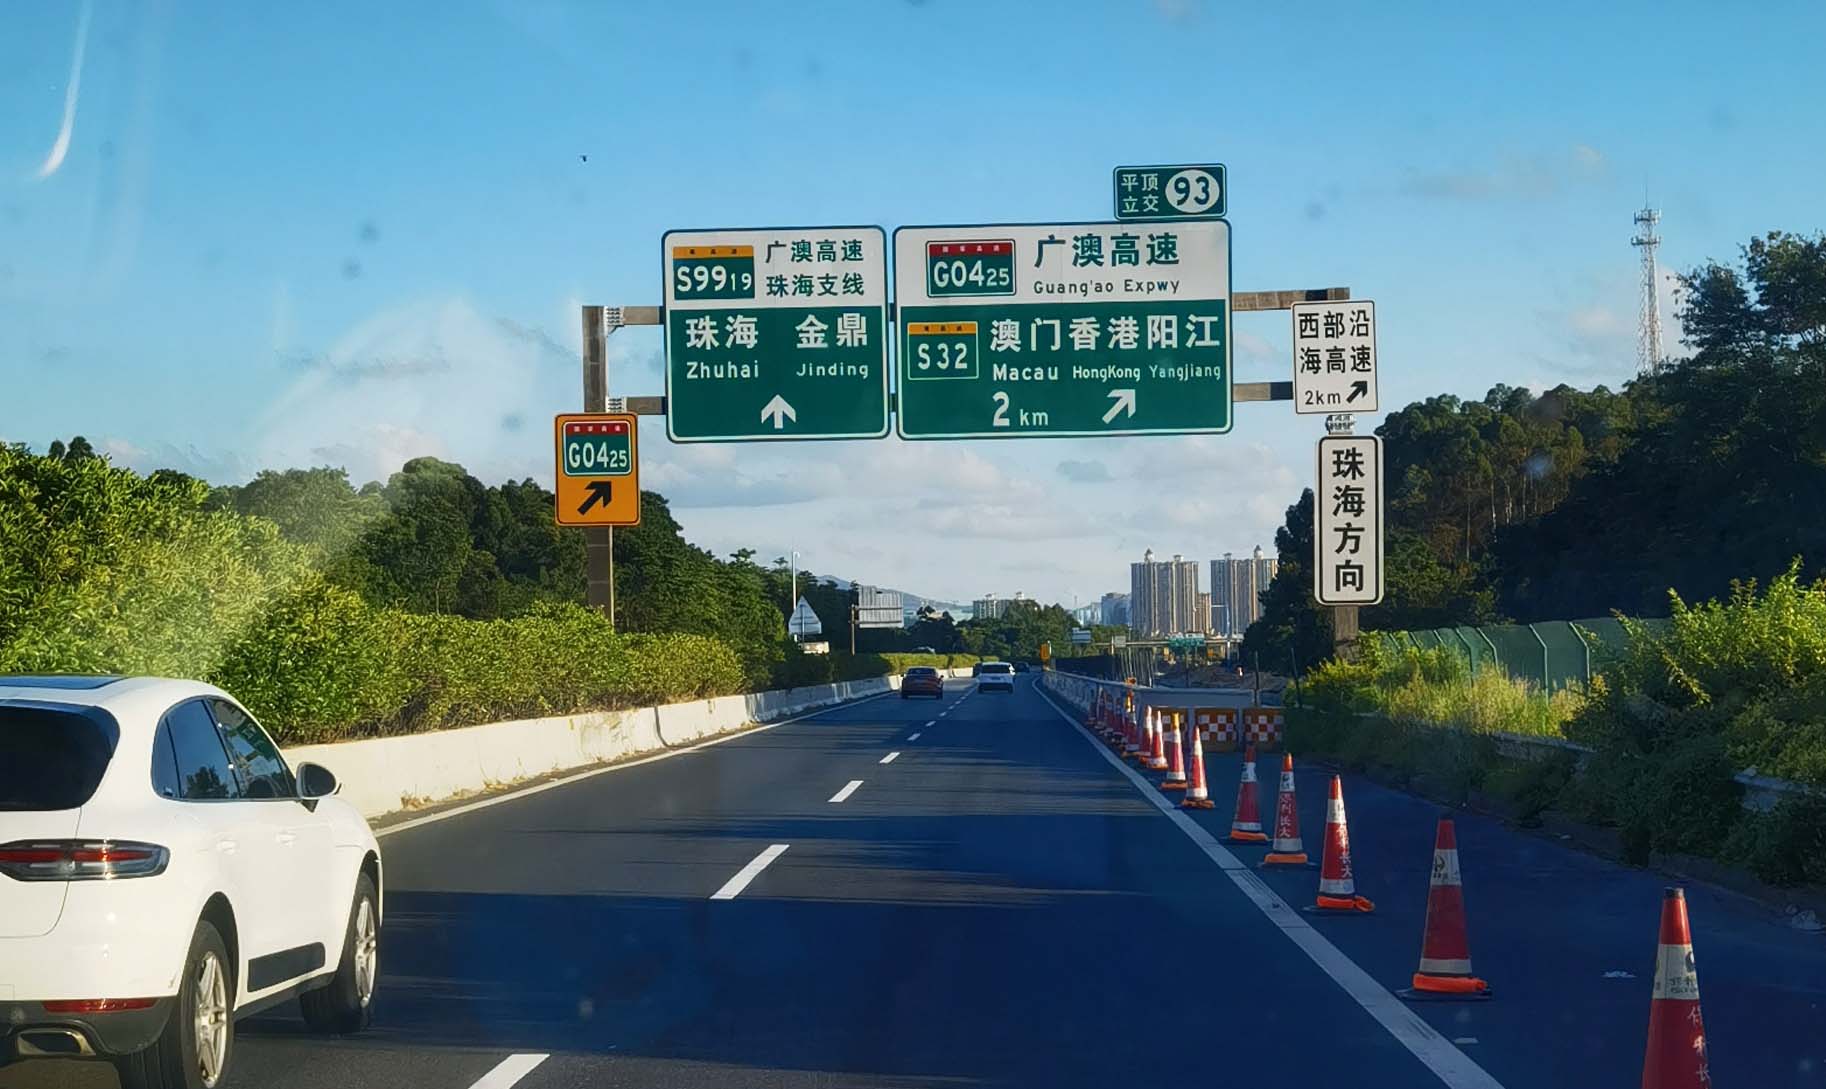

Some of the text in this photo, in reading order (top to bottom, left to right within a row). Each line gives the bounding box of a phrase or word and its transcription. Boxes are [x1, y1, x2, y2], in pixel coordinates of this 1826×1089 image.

[1122, 174, 1158, 191] 平顶
[1173, 176, 1210, 205] 93
[1122, 195, 1159, 212] 立交
[766, 240, 863, 263] 广澳高速
[1034, 233, 1179, 268] 广澳高速
[766, 273, 864, 297] 珠海支线
[934, 260, 1009, 288] G0425
[1034, 279, 1180, 296] Guang'ao Expwy
[686, 314, 868, 350] 珠海 金鼎
[1299, 310, 1370, 339] 西部沿
[918, 343, 968, 369] S32
[1300, 345, 1372, 374] 海高速
[686, 360, 868, 379] Zhuhai Jinding
[993, 364, 1221, 383] Macau HongKong Yangjiang
[992, 392, 1048, 427] 2 km
[569, 442, 627, 468] G0425
[1332, 448, 1365, 592] 珠海方向
